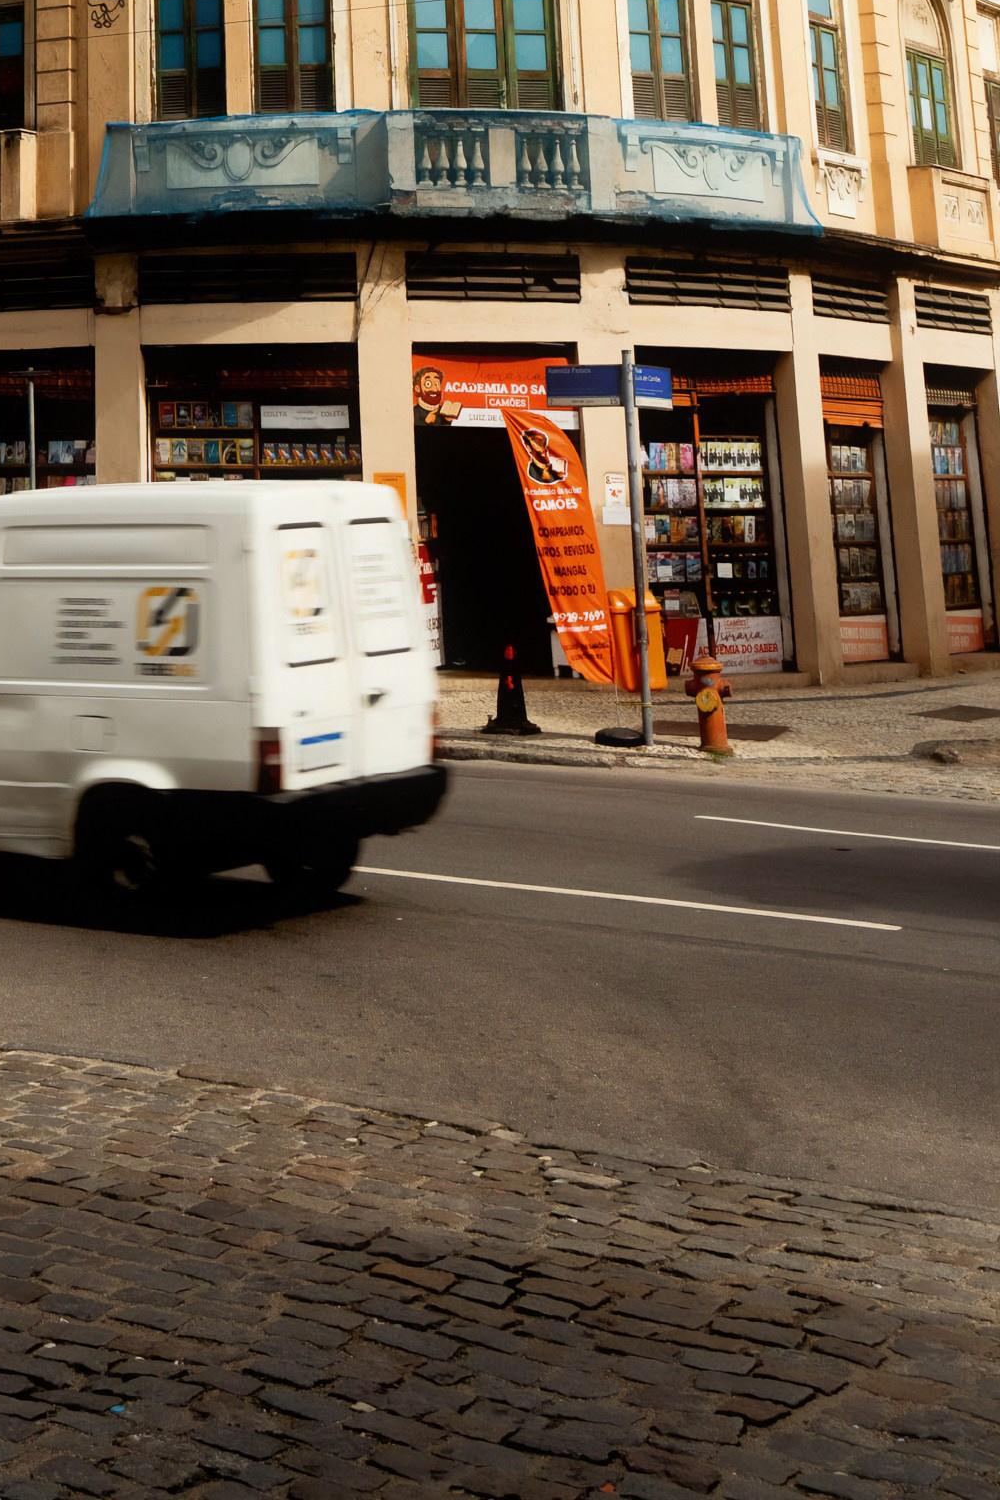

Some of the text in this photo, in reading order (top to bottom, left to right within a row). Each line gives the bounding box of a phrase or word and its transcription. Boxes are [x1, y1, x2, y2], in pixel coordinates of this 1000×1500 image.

[444, 381, 509, 394] ACADEMIA
[511, 383, 528, 395] DO
[489, 396, 527, 408] CAMÕES
[533, 496, 579, 511] CAMÕES
[538, 525, 585, 538] COMPRAMOS
[563, 543, 595, 557] REVISTAS
[553, 565, 587, 577] MANGAS
[557, 585, 579, 597] ODO
[580, 584, 587, 596] O
[698, 643, 779, 655] ACDEMIA DO SABER
